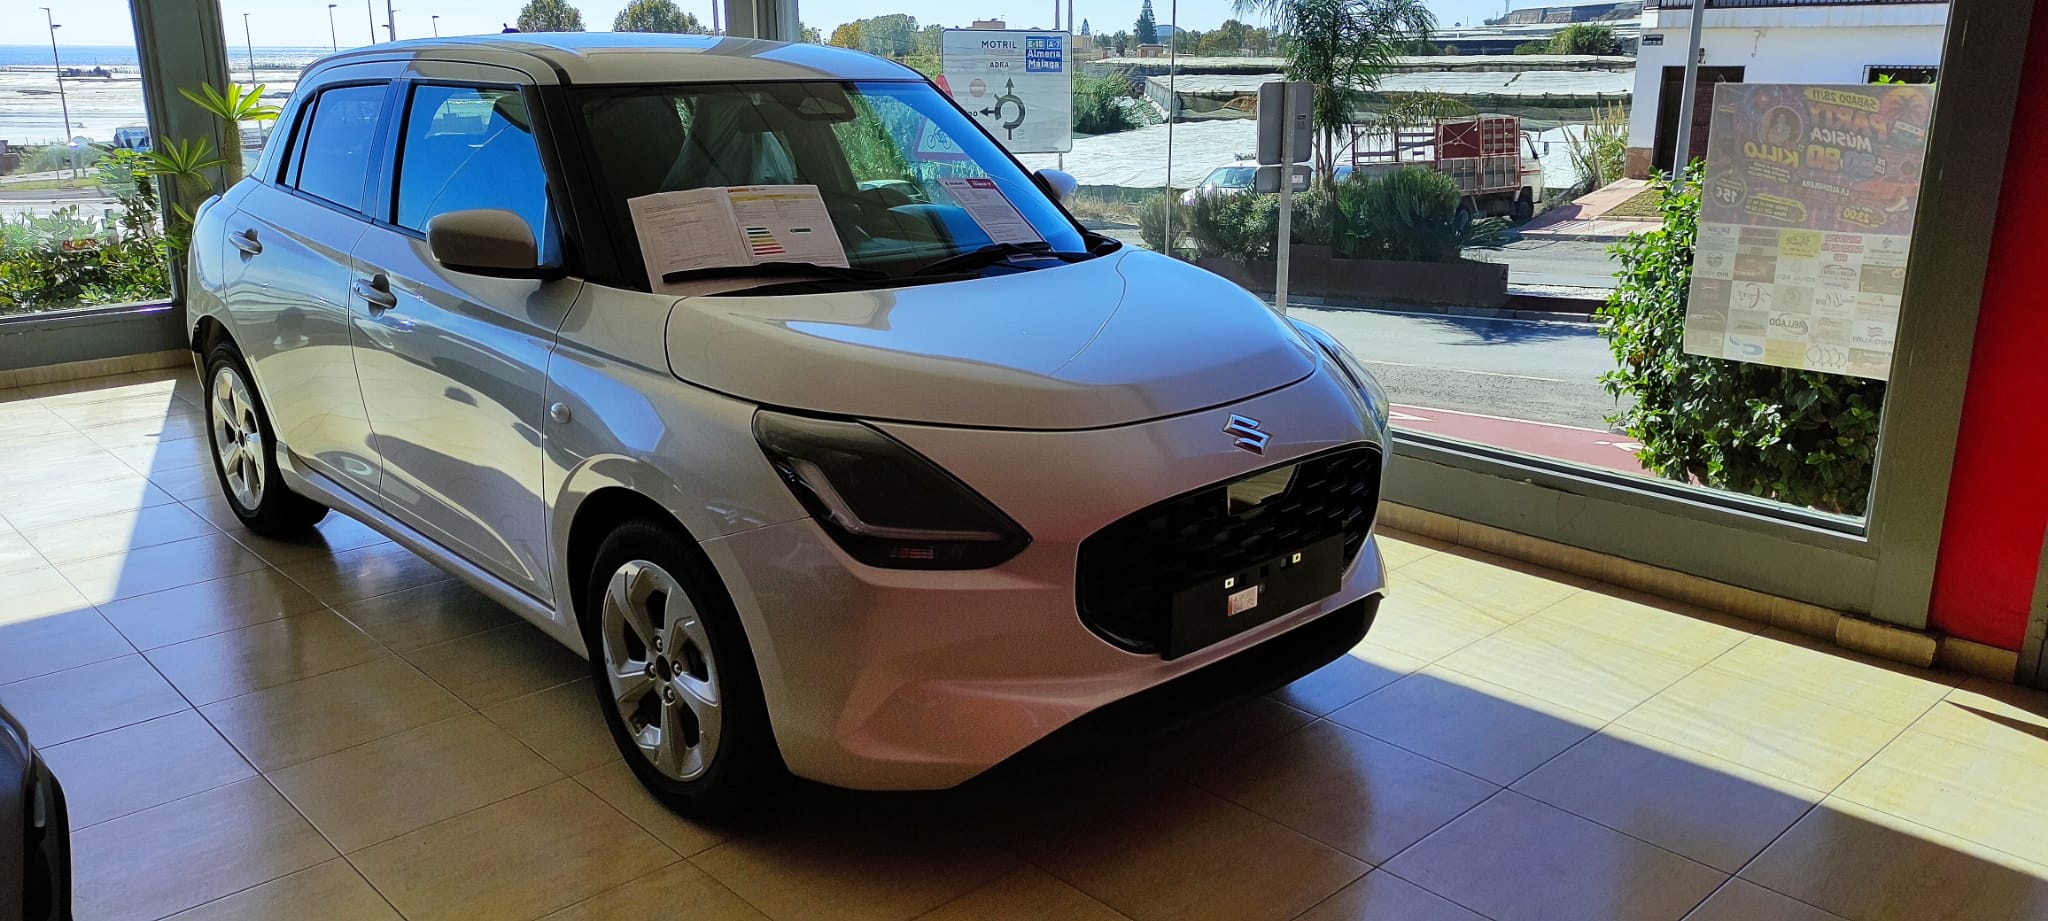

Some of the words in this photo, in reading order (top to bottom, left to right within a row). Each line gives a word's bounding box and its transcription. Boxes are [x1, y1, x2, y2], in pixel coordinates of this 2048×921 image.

[981, 40, 1017, 49] MOTRIL
[1027, 40, 1044, 49] E-15
[989, 61, 1009, 69] ADRA
[1028, 59, 1060, 69] Málaga
